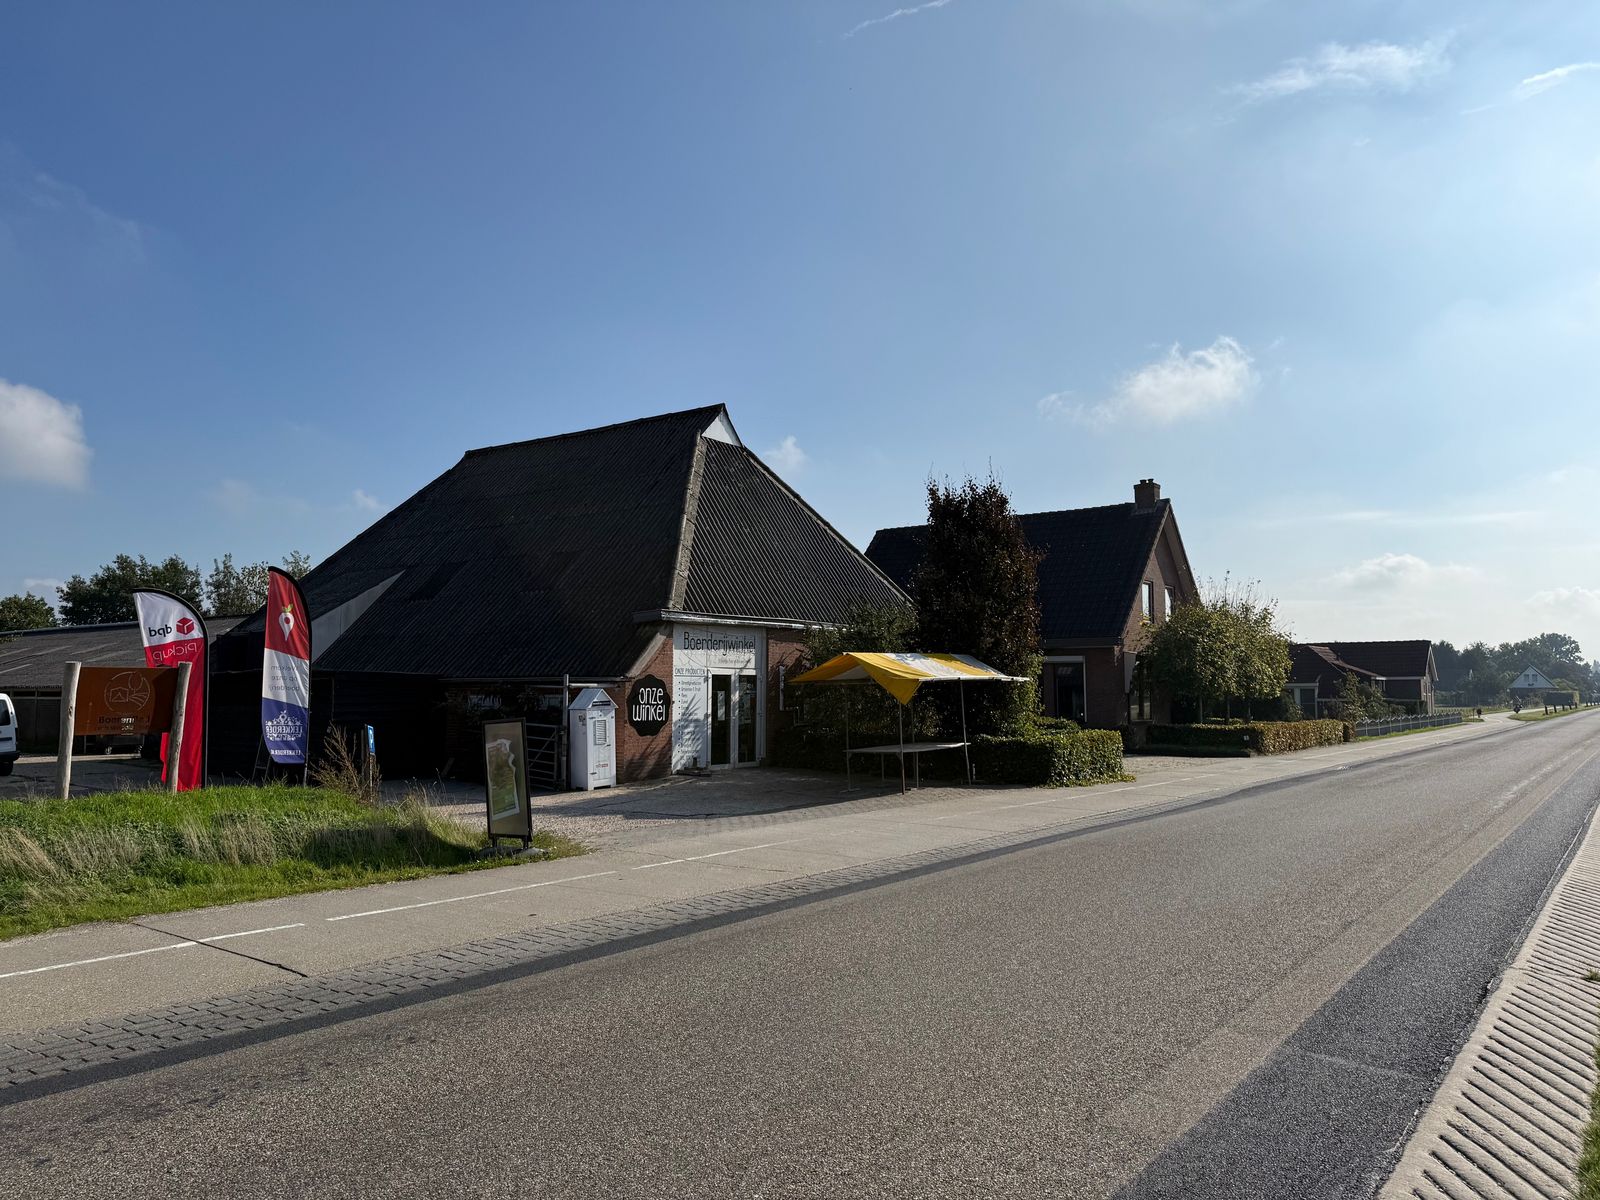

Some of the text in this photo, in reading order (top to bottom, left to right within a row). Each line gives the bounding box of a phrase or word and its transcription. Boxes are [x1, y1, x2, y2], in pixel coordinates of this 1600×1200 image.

[683, 631, 756, 655] Boerderijwinkel
[639, 687, 664, 704] onze
[632, 703, 666, 722] winkel
